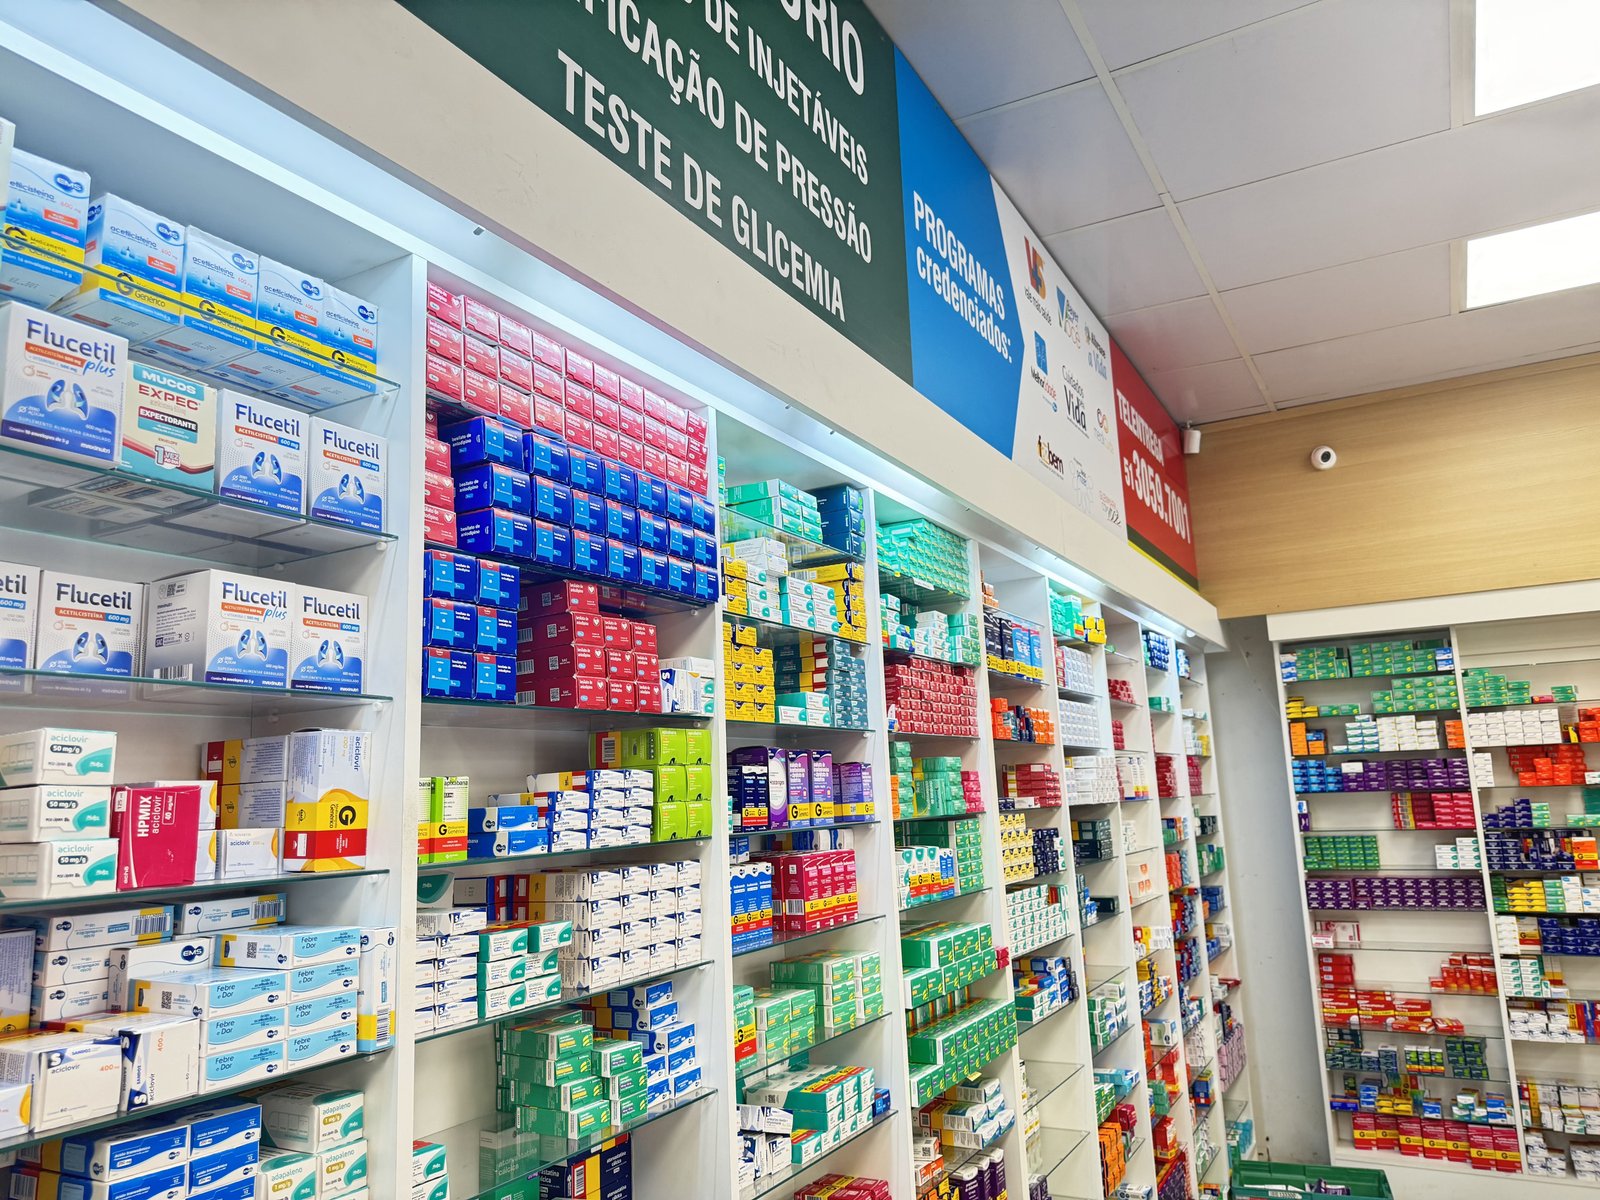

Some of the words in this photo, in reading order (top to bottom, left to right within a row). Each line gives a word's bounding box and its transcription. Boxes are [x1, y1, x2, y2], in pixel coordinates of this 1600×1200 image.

[705, 0, 739, 55] DE
[748, 25, 868, 185] INJETÁVEIS
[580, 0, 725, 130] ICAÇÃO
[735, 100, 768, 171] DE
[776, 139, 871, 263] PRESSÃO
[557, 48, 672, 190] TESTE
[684, 152, 722, 228] DE
[732, 195, 845, 322] GLICEMIA
[913, 190, 1005, 320] PROGRAMAS
[916, 246, 1012, 364] credenciados:
[26, 318, 116, 366] Flucetil
[83, 360, 117, 378] plus
[141, 369, 197, 395] MUCOS
[138, 384, 199, 411] EXPEC
[1064, 385, 1086, 431] Vida
[140, 408, 197, 431] EXPECTORANTE
[235, 402, 301, 438] Flucetil
[1117, 388, 1165, 467] TELENTREGA
[237, 426, 277, 443] ACETILCISTEÍNA
[280, 437, 291, 447] 600
[291, 441, 300, 450] mg
[323, 428, 380, 460] Flucetil
[155, 444, 165, 465] 1
[165, 451, 180, 461] VEZ
[325, 451, 360, 466] ACETILCISTEÍNA
[362, 460, 371, 469] 600
[371, 464, 379, 472] mg
[1123, 456, 1135, 491] 51
[1132, 450, 1191, 544] 3059.7001
[0, 575, 27, 595] til
[56, 582, 132, 610] Flucetil
[222, 581, 288, 609] Flucetil
[13, 601, 24, 609] mg
[303, 595, 361, 620] Flucetil
[59, 609, 104, 620] ACETILCISTEÍNA
[108, 614, 119, 622] 600
[120, 616, 130, 624] mg
[263, 605, 288, 622] plus
[305, 619, 339, 629] ACETILCISTEÍNA
[50, 734, 89, 743] aciclovir
[62, 745, 82, 754] mg/g
[47, 788, 84, 797] aciclovir
[58, 801, 78, 809] mg/g
[791, 805, 798, 819] G
[815, 803, 822, 817] G
[137, 795, 153, 838] HPMIX
[151, 795, 163, 834] aciclovir
[164, 811, 172, 820] 40
[338, 805, 357, 827] G
[438, 824, 448, 836] G
[57, 844, 94, 853] aciclovir
[69, 856, 88, 865] mg/g
[301, 935, 318, 943] Febre
[298, 969, 315, 978] Febre
[216, 983, 235, 992] Febre
[295, 1002, 312, 1013] Febre
[301, 1009, 311, 1017] Dor
[216, 1019, 235, 1029] Febre
[221, 1026, 233, 1035] Dor
[294, 1036, 311, 1046] Febre
[738, 1029, 744, 1043] G
[299, 1043, 309, 1051] Dor
[50, 1053, 62, 1066] S
[215, 1055, 235, 1065] Febre
[221, 1062, 232, 1071] Dor
[51, 1063, 80, 1074] aciclovir
[100, 1064, 114, 1072] 400
[134, 1094, 148, 1105] S
[322, 1102, 351, 1115] adapaleno
[325, 1149, 355, 1164] adapaleno
[271, 1167, 303, 1182] adapaleno
